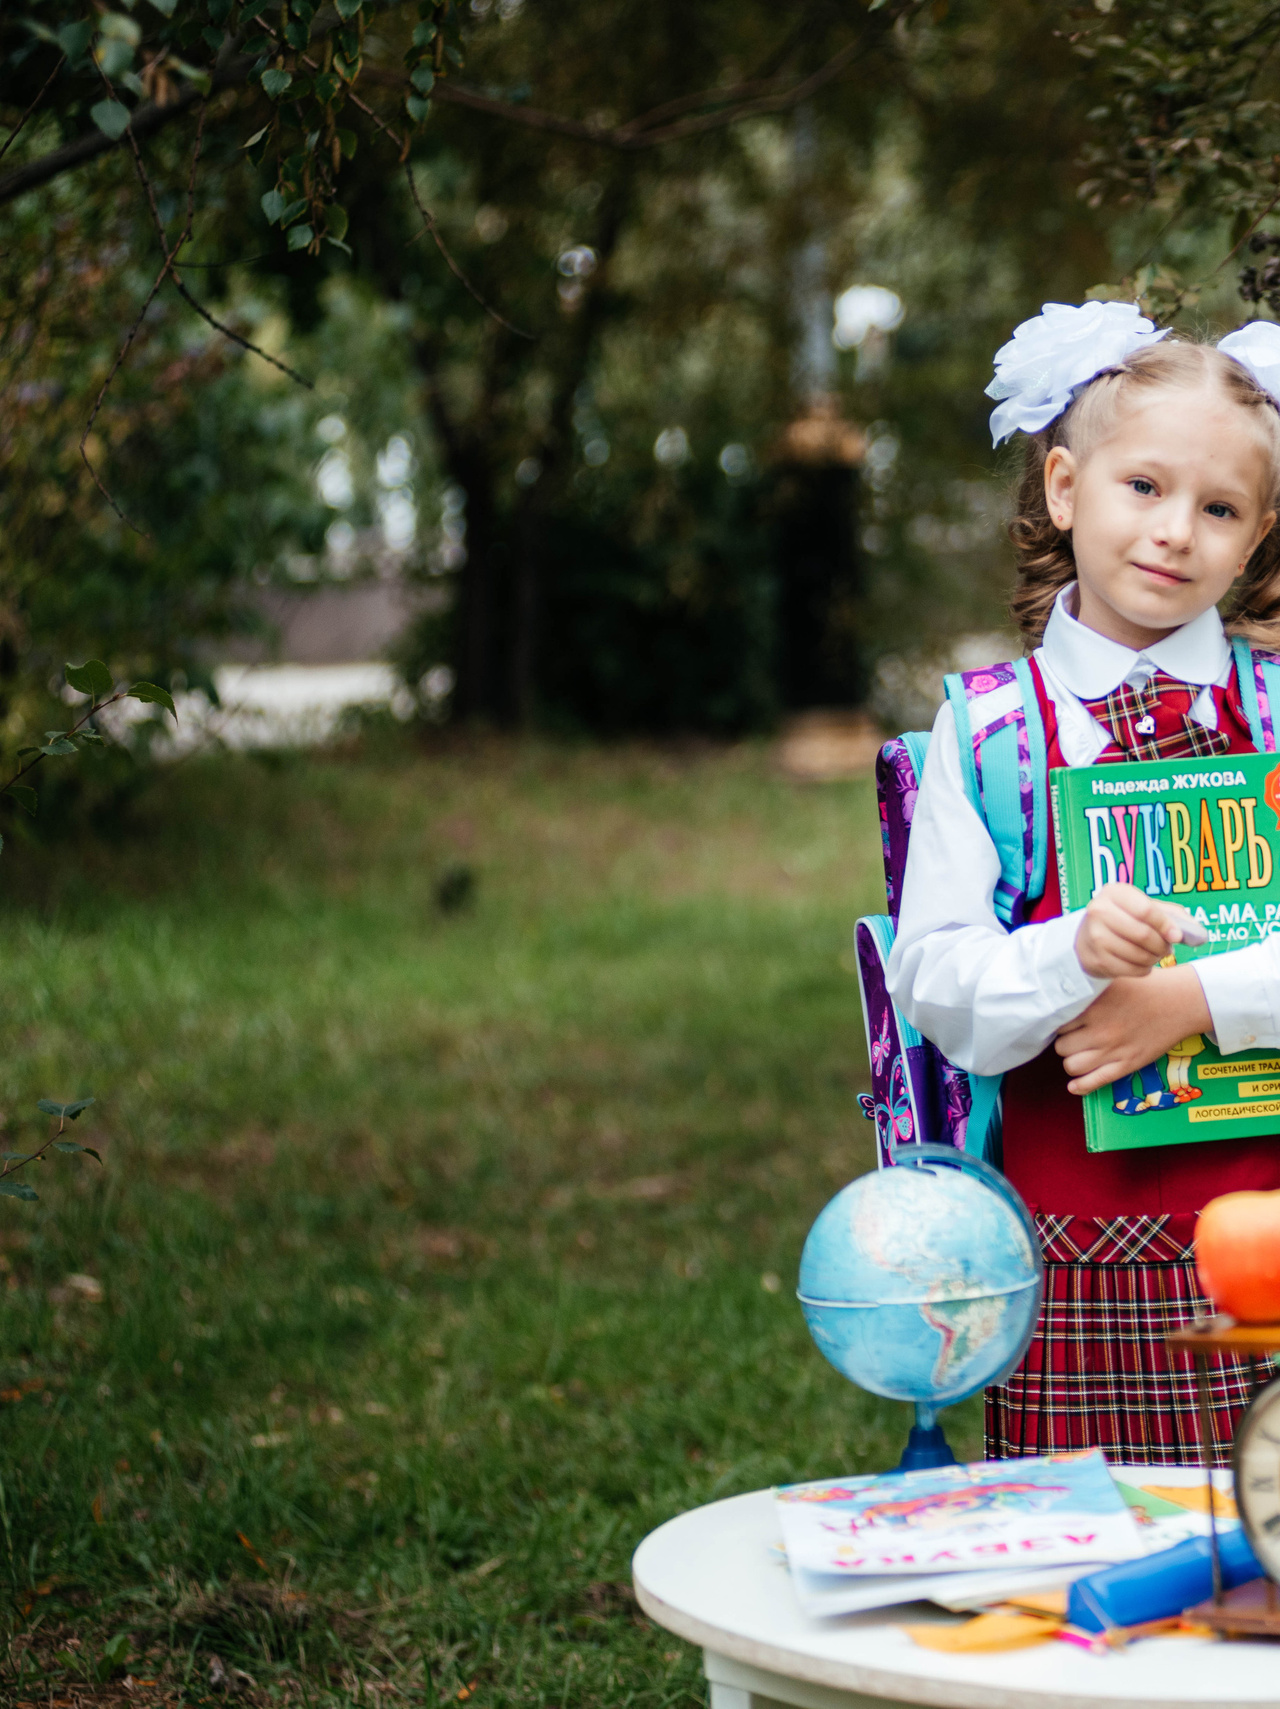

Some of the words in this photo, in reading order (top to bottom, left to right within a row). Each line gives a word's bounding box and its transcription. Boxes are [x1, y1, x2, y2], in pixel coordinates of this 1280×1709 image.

[1091, 778, 1170, 796] Надежда
[1172, 770, 1247, 790] ЖУКОВА
[1051, 784, 1063, 850] Надежда
[1084, 797, 1273, 897] БУКВАРЬ
[1184, 902, 1258, 926] А-МА
[1202, 1063, 1257, 1077] СОЧЕТАНИЕ
[1252, 1083, 1260, 1093] И
